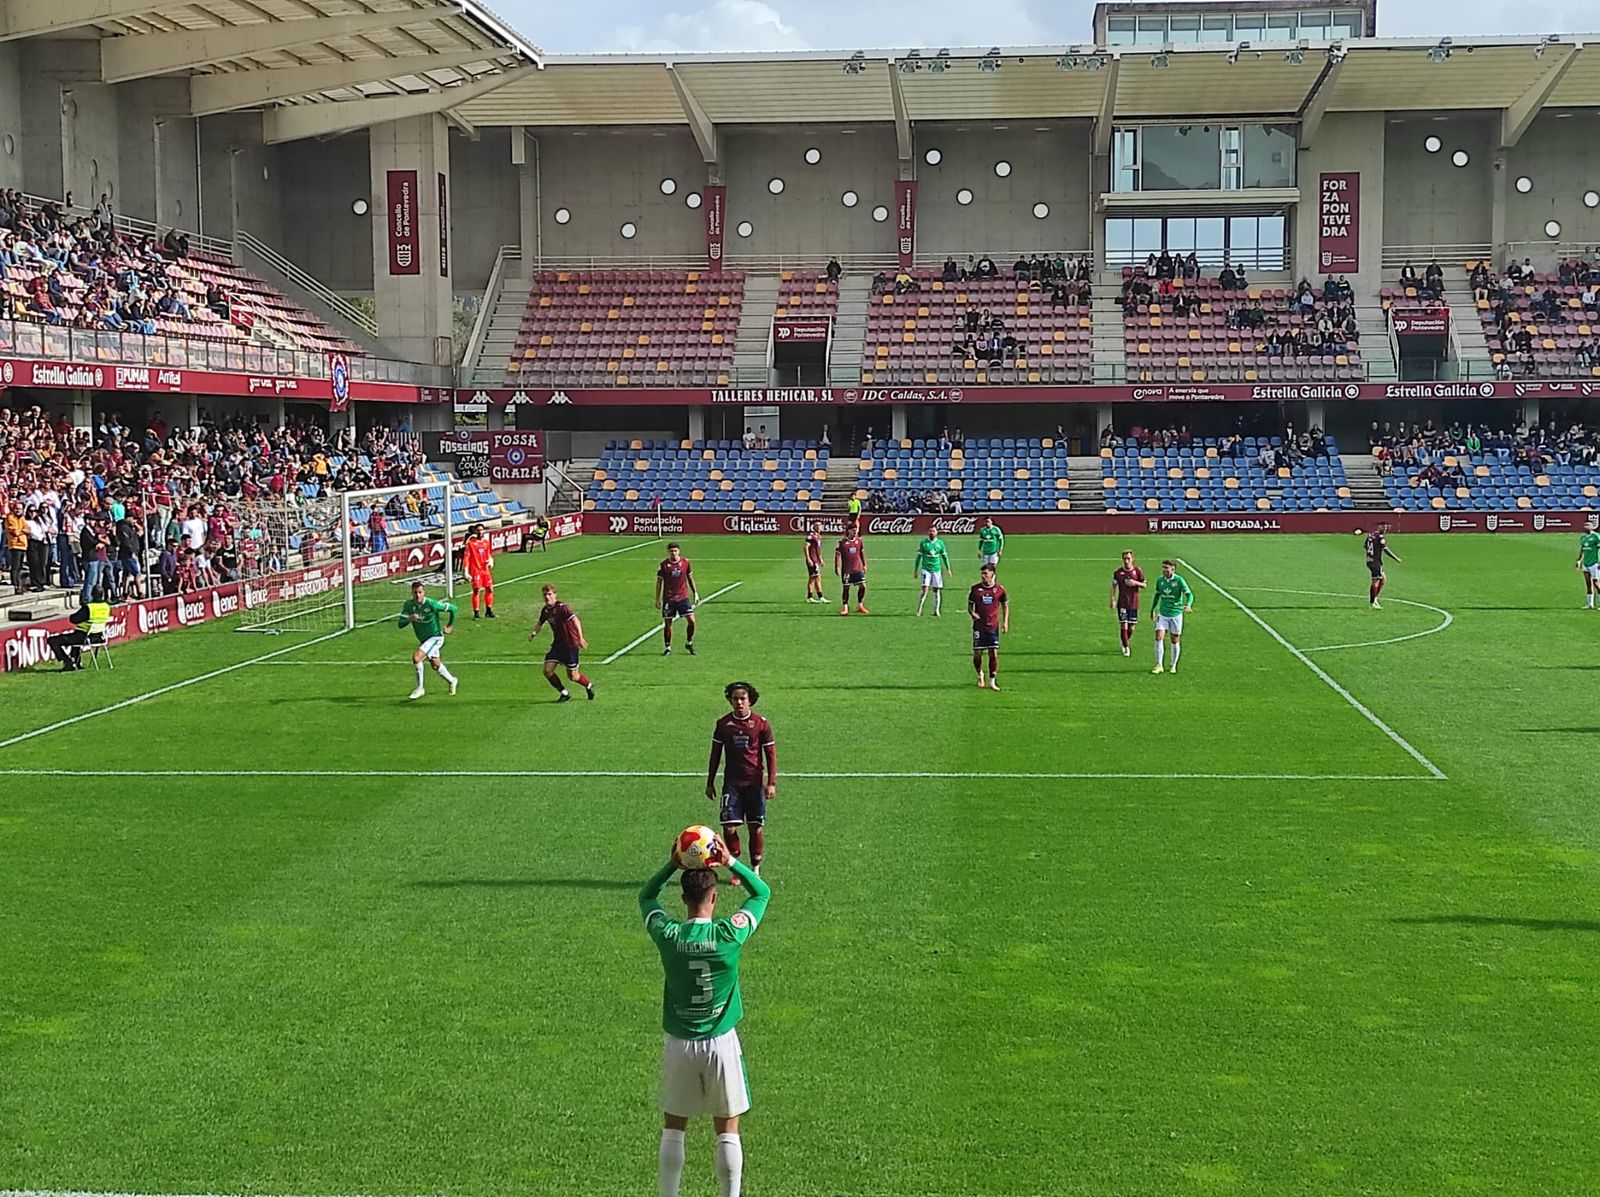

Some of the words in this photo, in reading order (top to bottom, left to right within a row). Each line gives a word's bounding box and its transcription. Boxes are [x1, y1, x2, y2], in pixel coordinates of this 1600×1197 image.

[1322, 180, 1347, 190] FOR
[402, 182, 411, 225] Pontevedra
[1322, 192, 1339, 202] ZA
[1322, 203, 1349, 213] PON
[394, 204, 403, 237] Concello
[1322, 215, 1351, 225] TEVE
[403, 226, 410, 237] de
[1322, 226, 1348, 237] DRA
[33, 363, 65, 386] Estrella
[66, 367, 94, 387] Galicia
[123, 367, 149, 383] PUMAR
[711, 389, 763, 402] TALLERES
[766, 389, 818, 403] HEMICAR,
[821, 389, 834, 401] SL
[861, 389, 888, 401] IDC
[890, 390, 925, 402] Caldas,
[1252, 385, 1298, 400] Estrella
[1300, 385, 1342, 399] Galicia
[1386, 384, 1431, 398] Estrella
[1434, 384, 1477, 397] Galicia
[494, 434, 538, 449] FOSSA
[493, 465, 541, 481] GRANA
[1161, 520, 1206, 530] PINTURAS
[219, 595, 238, 613] ence
[147, 609, 169, 627] ence
[185, 603, 206, 622] ence
[688, 960, 713, 1004] 3
